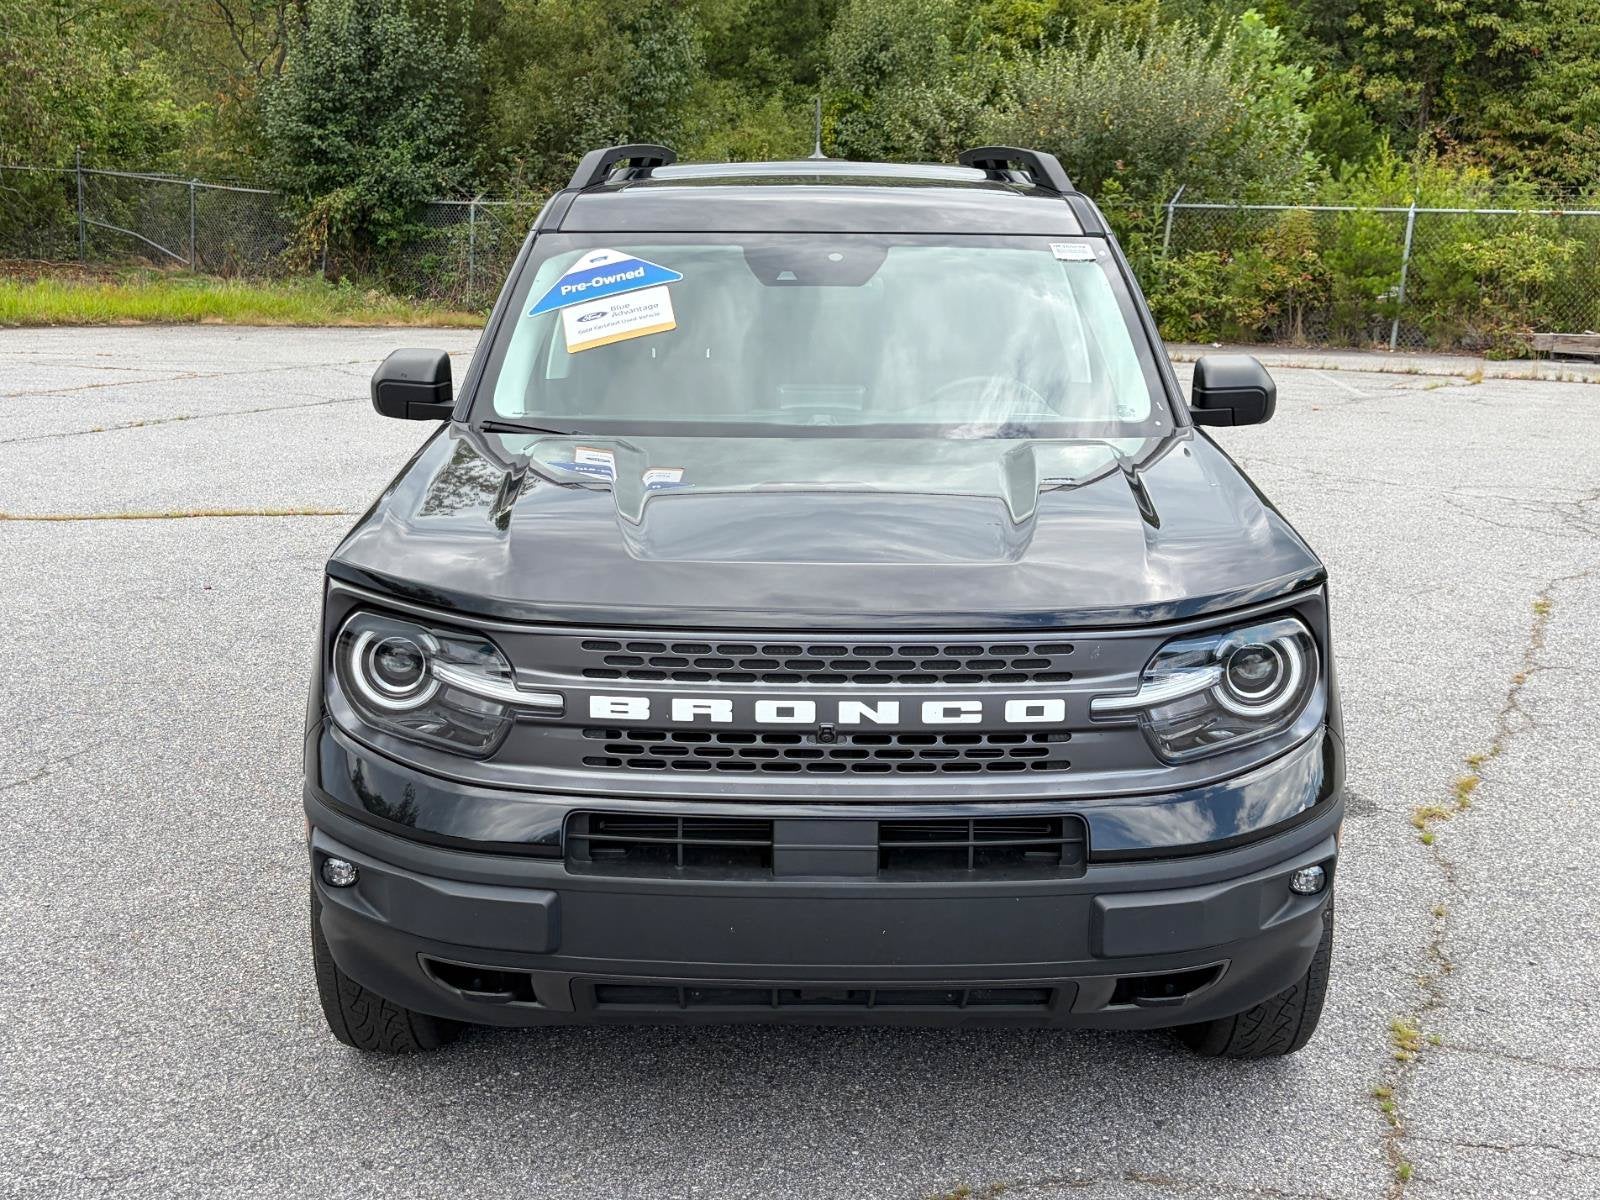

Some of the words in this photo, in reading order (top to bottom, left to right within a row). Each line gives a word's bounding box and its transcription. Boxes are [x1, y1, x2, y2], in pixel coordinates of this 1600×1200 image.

[561, 266, 645, 296] Pre-Owned
[610, 303, 631, 312] Blue
[611, 303, 659, 318] Advantage
[589, 694, 1066, 725] BRONCO
